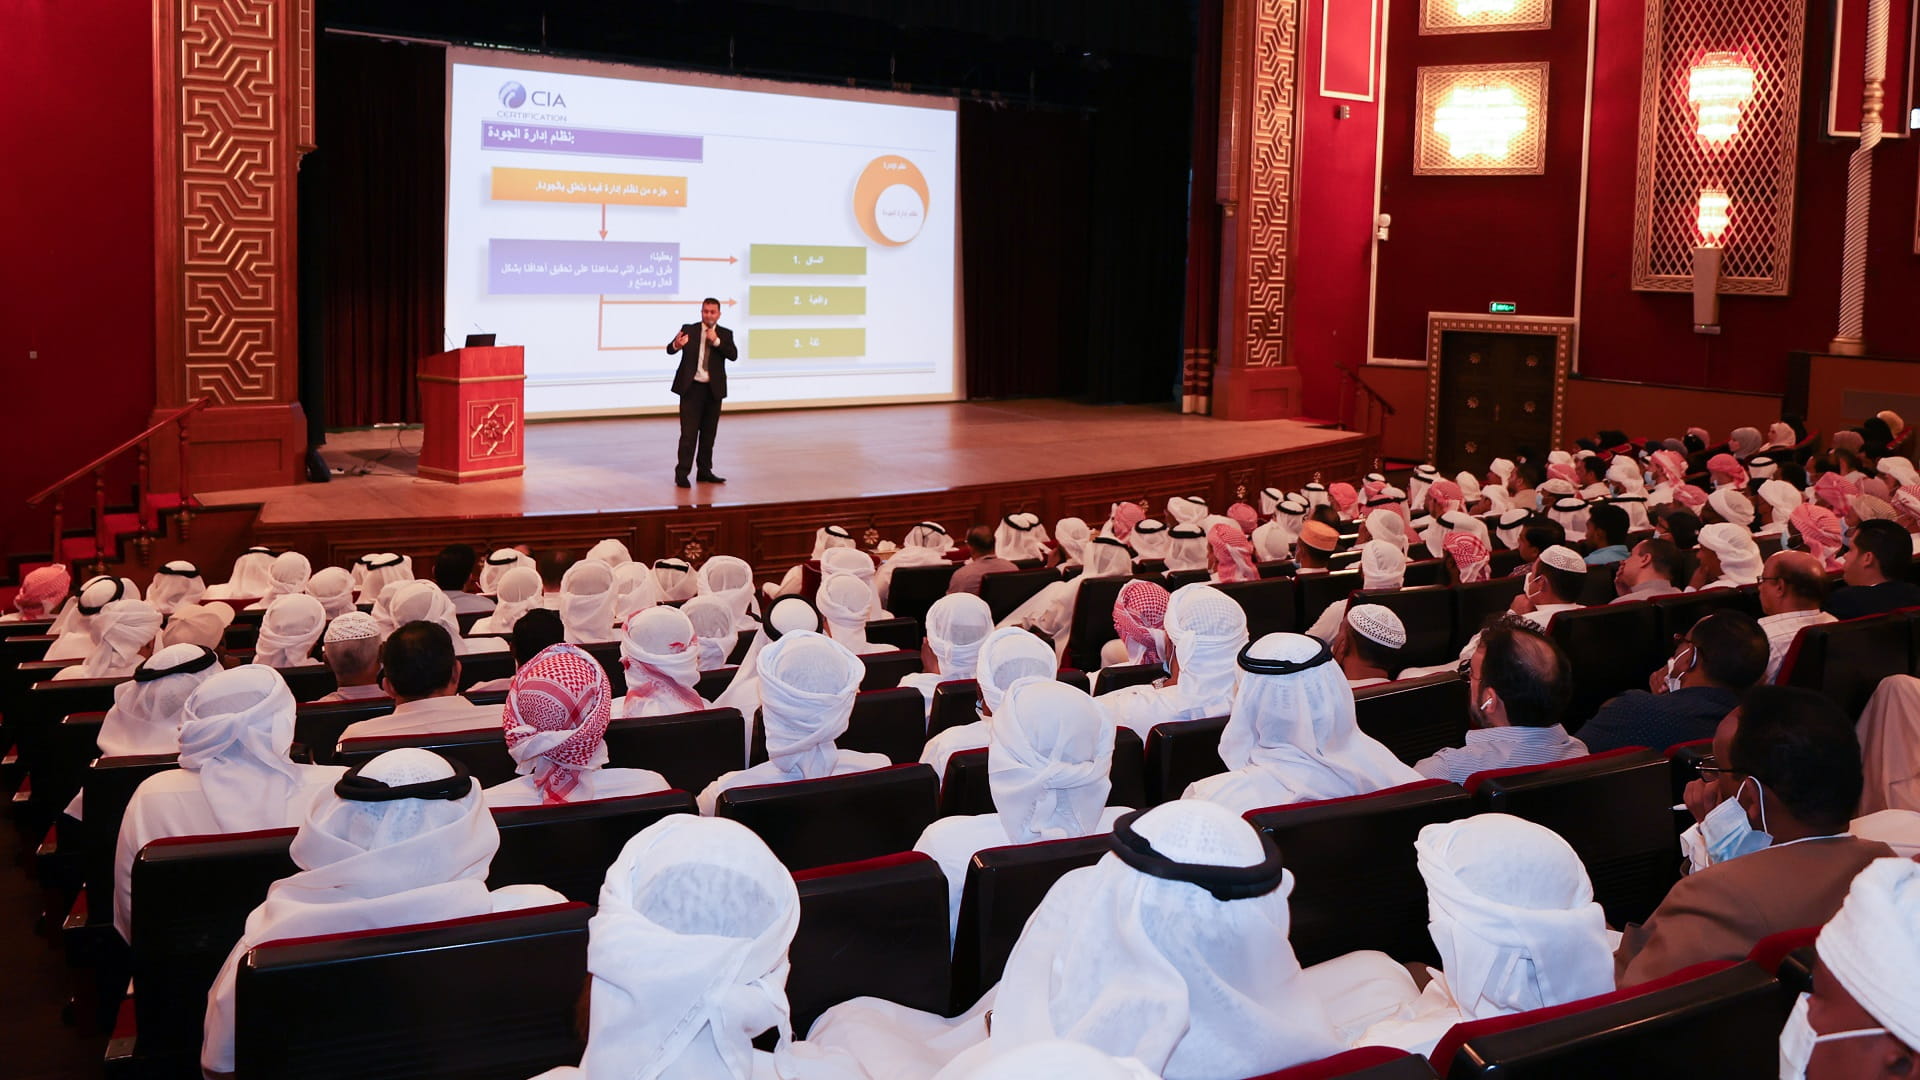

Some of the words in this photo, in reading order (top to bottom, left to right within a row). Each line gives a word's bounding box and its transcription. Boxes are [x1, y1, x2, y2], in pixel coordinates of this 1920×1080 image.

[531, 91, 567, 108] CIA
[496, 110, 568, 122] CERTIFICATION
[487, 125, 521, 142] الجودة
[523, 128, 547, 144] إدارة
